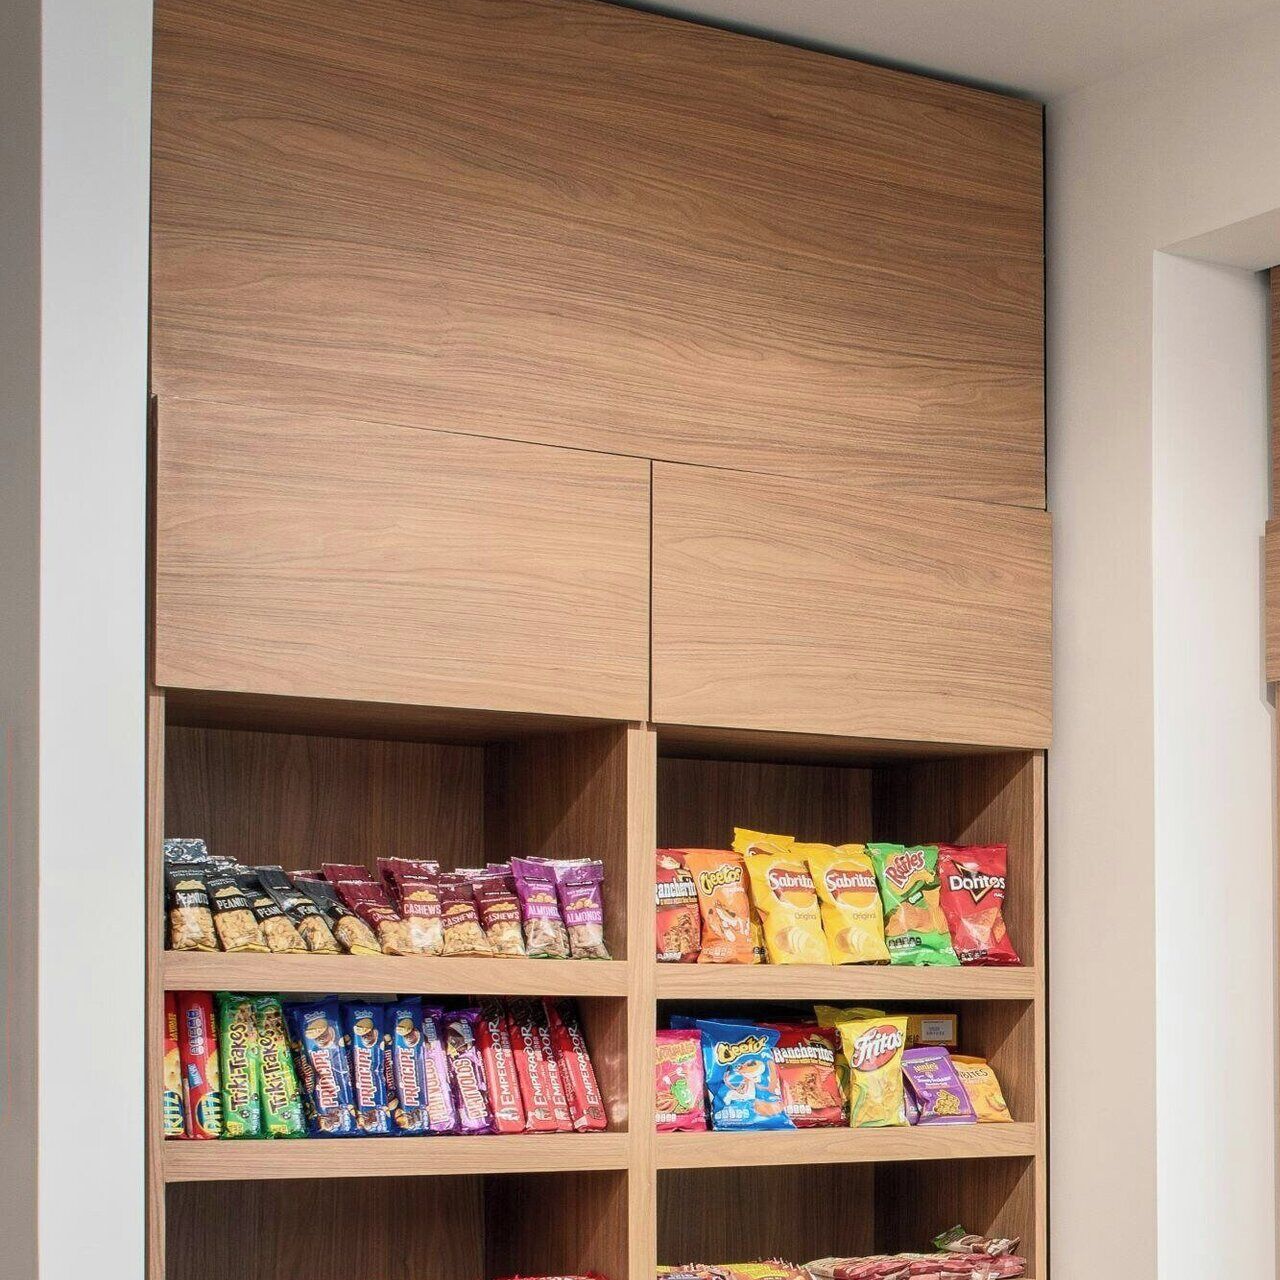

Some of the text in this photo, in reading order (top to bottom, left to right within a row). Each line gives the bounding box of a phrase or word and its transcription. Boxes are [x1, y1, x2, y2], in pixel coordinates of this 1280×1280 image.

[885, 850, 925, 888] Ruffles
[656, 878, 697, 902] ancherit
[950, 875, 1005, 890] Doritos
[403, 904, 442, 915] CASHEWS
[566, 911, 602, 923] ALMONDS
[773, 1043, 835, 1065] Rancheritos
[852, 1027, 903, 1067] Fritos
[227, 1023, 249, 1111] Triki-Trakes
[959, 1068, 988, 1080] BITES
